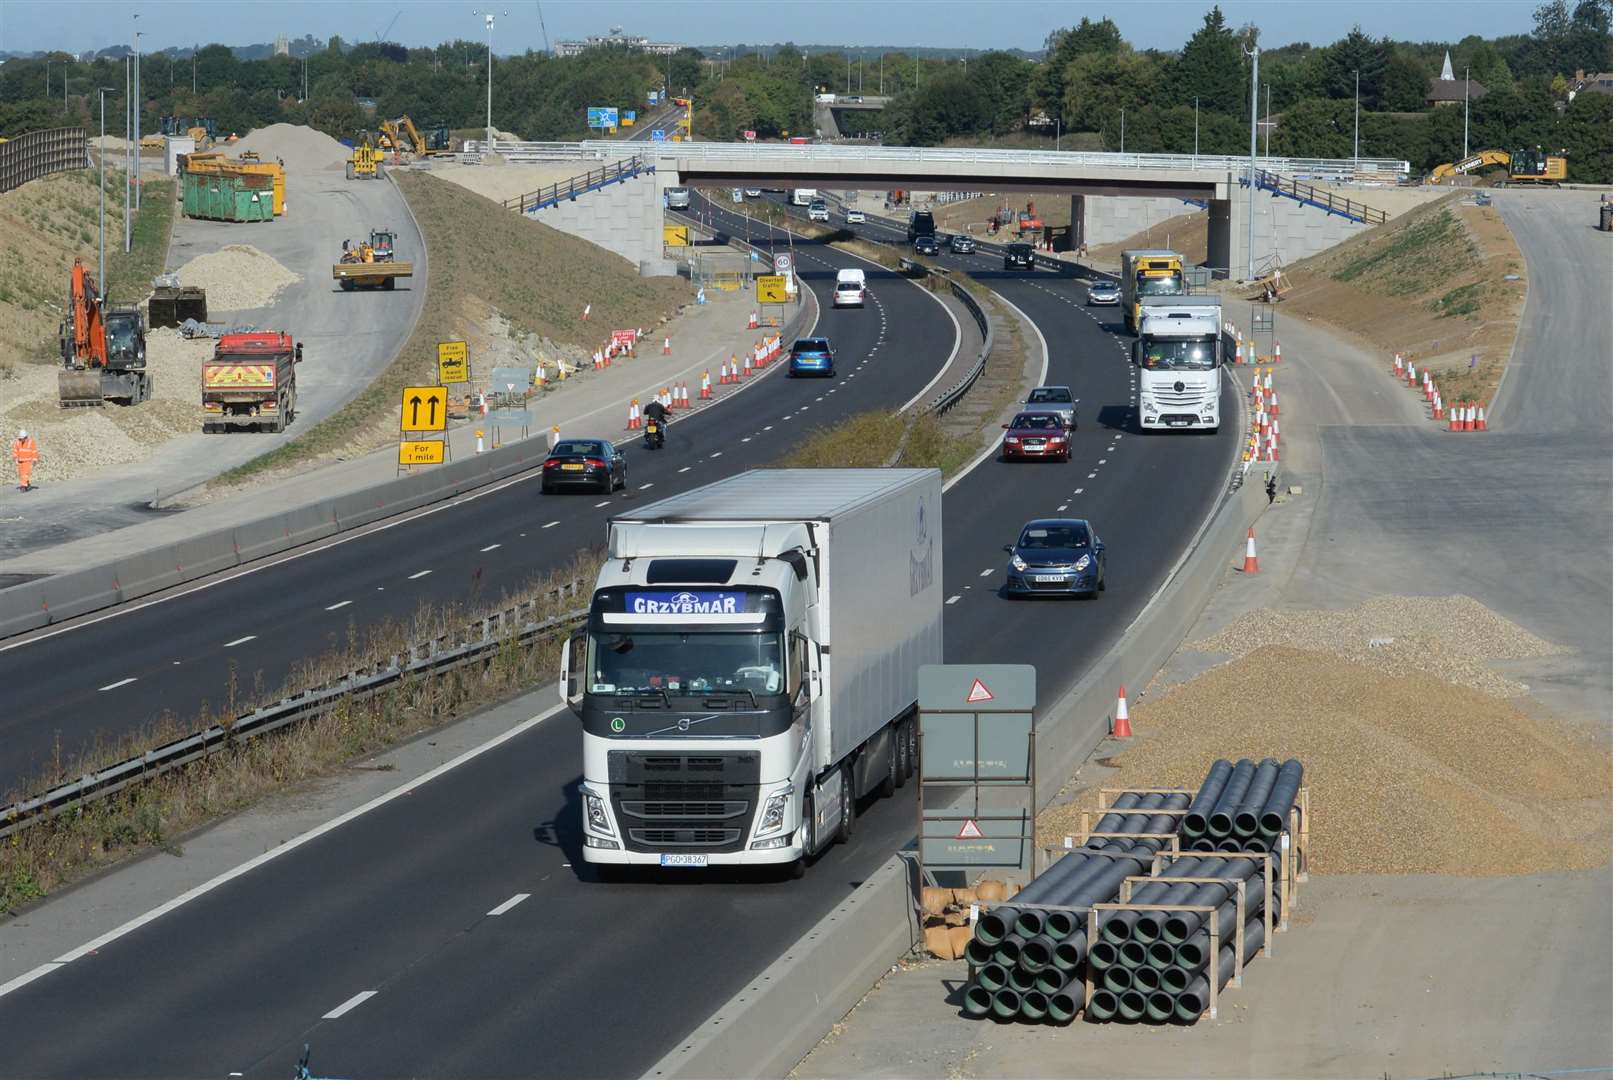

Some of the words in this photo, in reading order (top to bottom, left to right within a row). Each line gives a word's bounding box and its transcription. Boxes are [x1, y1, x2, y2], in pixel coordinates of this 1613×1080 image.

[1456, 159, 1482, 173] FLANNERY
[415, 453, 434, 461] mile
[634, 597, 736, 613] GRZYBMAR
[666, 855, 681, 864] PGO
[683, 855, 706, 864] 38367
